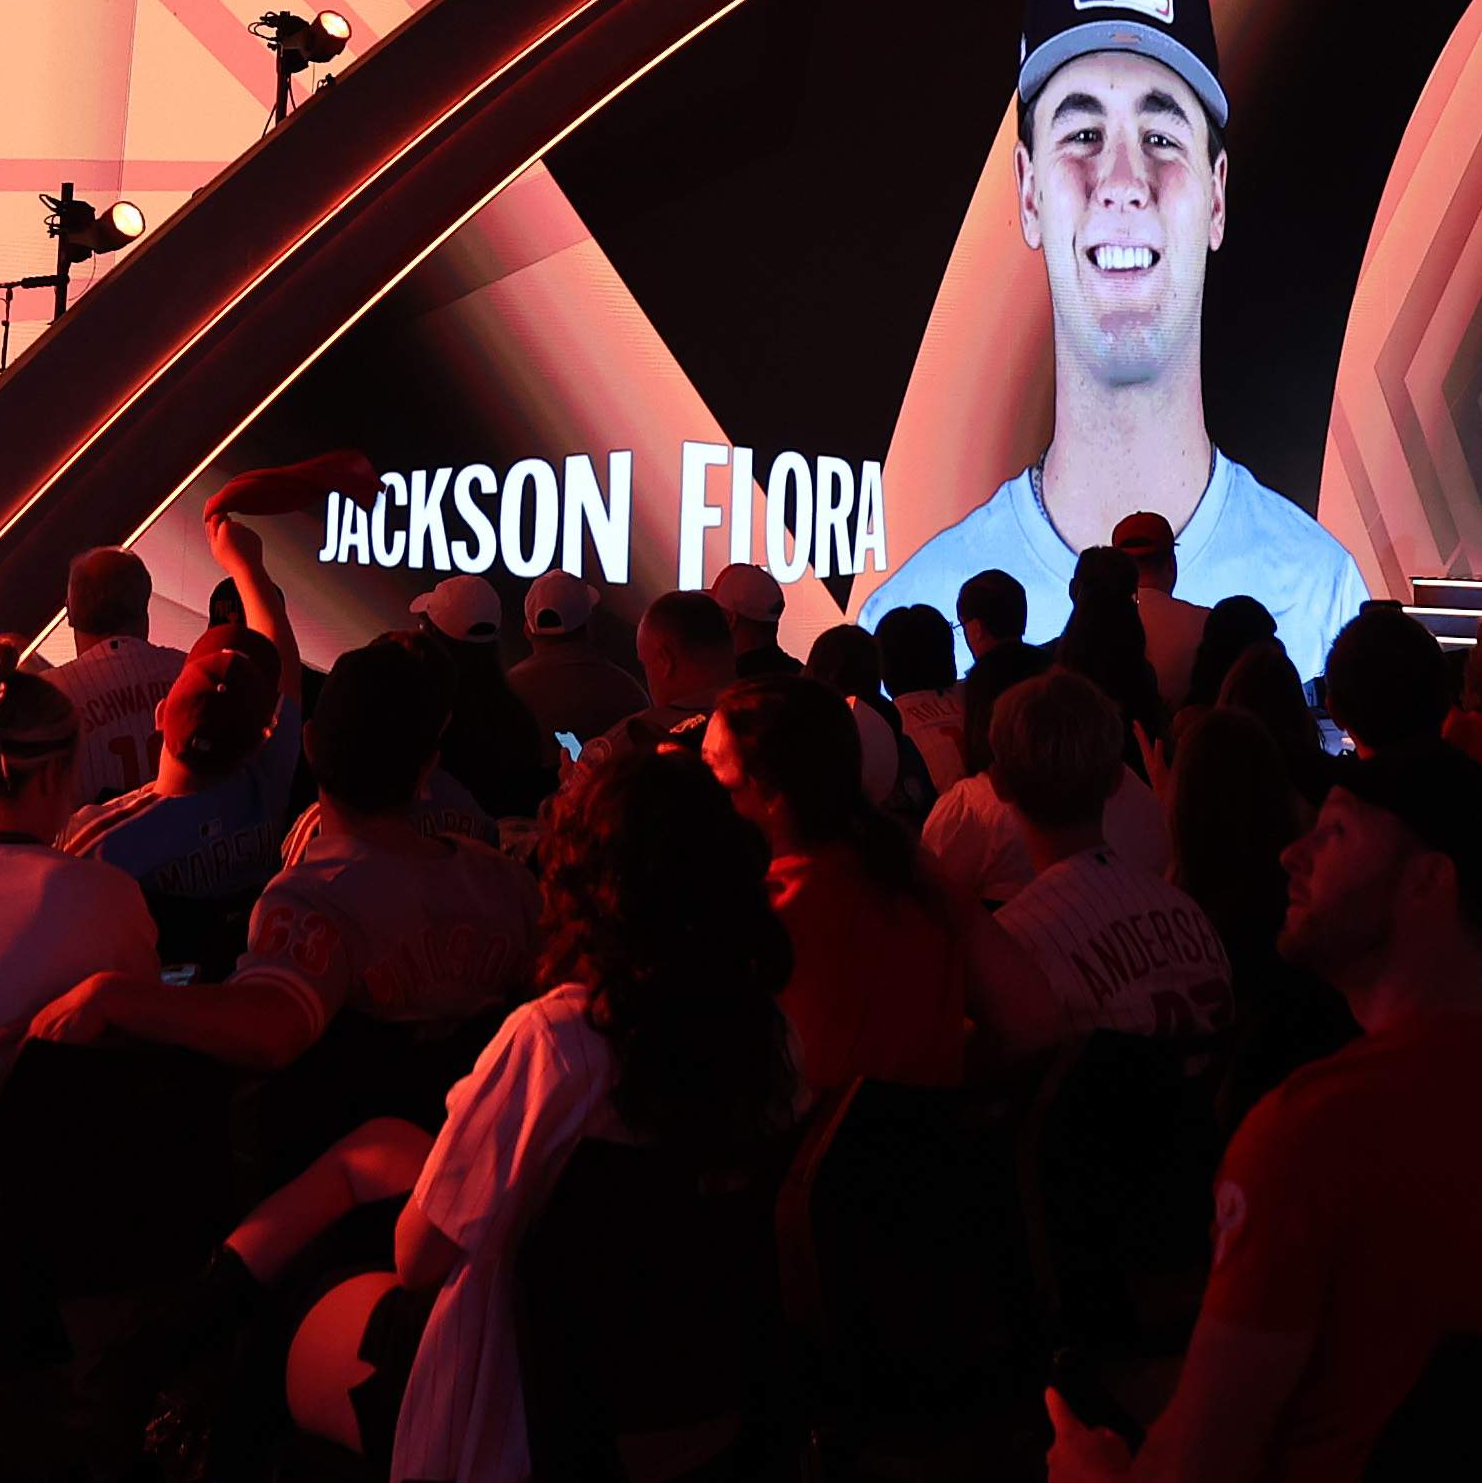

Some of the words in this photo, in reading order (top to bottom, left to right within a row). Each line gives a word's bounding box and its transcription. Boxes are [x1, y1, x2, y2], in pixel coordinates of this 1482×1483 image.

[319, 448, 633, 585] JACKSON
[677, 439, 889, 591] FLORA
[84, 682, 172, 734] SCHWAR
[1071, 906, 1227, 1008] ANDERSE
